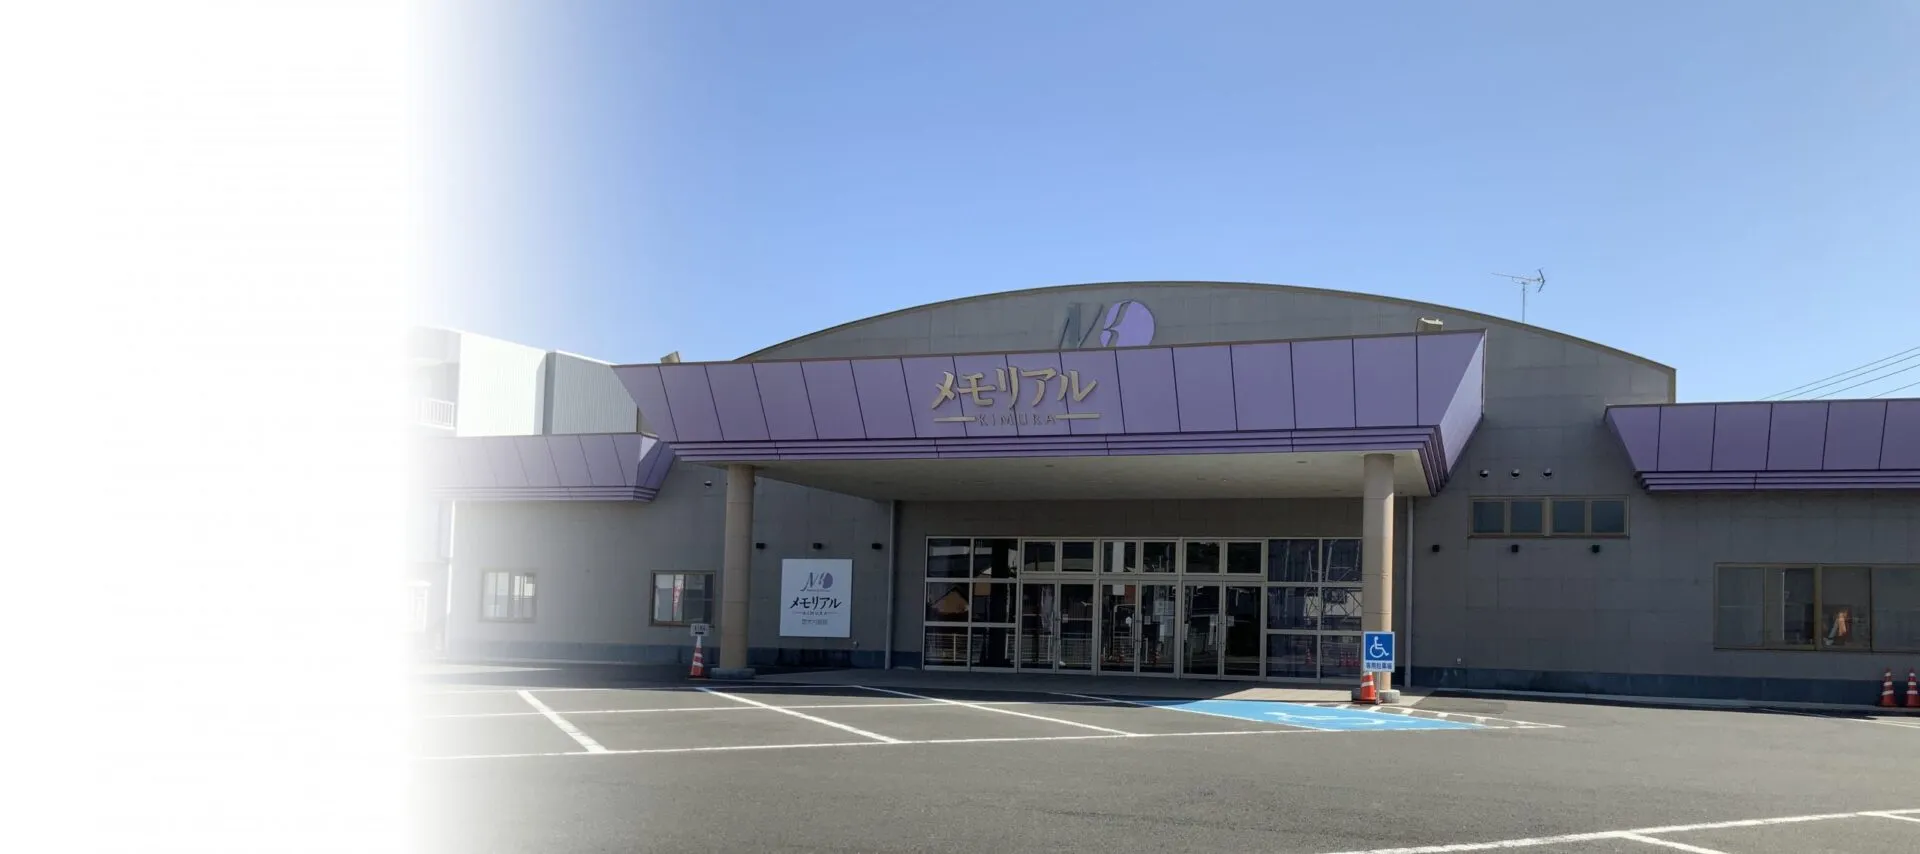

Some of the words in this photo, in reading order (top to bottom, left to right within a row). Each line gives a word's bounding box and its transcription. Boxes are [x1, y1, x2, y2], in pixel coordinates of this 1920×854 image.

[931, 366, 1098, 410] メモリアル
[977, 411, 1057, 427] KIMURA
[789, 596, 842, 610] メモリアル
